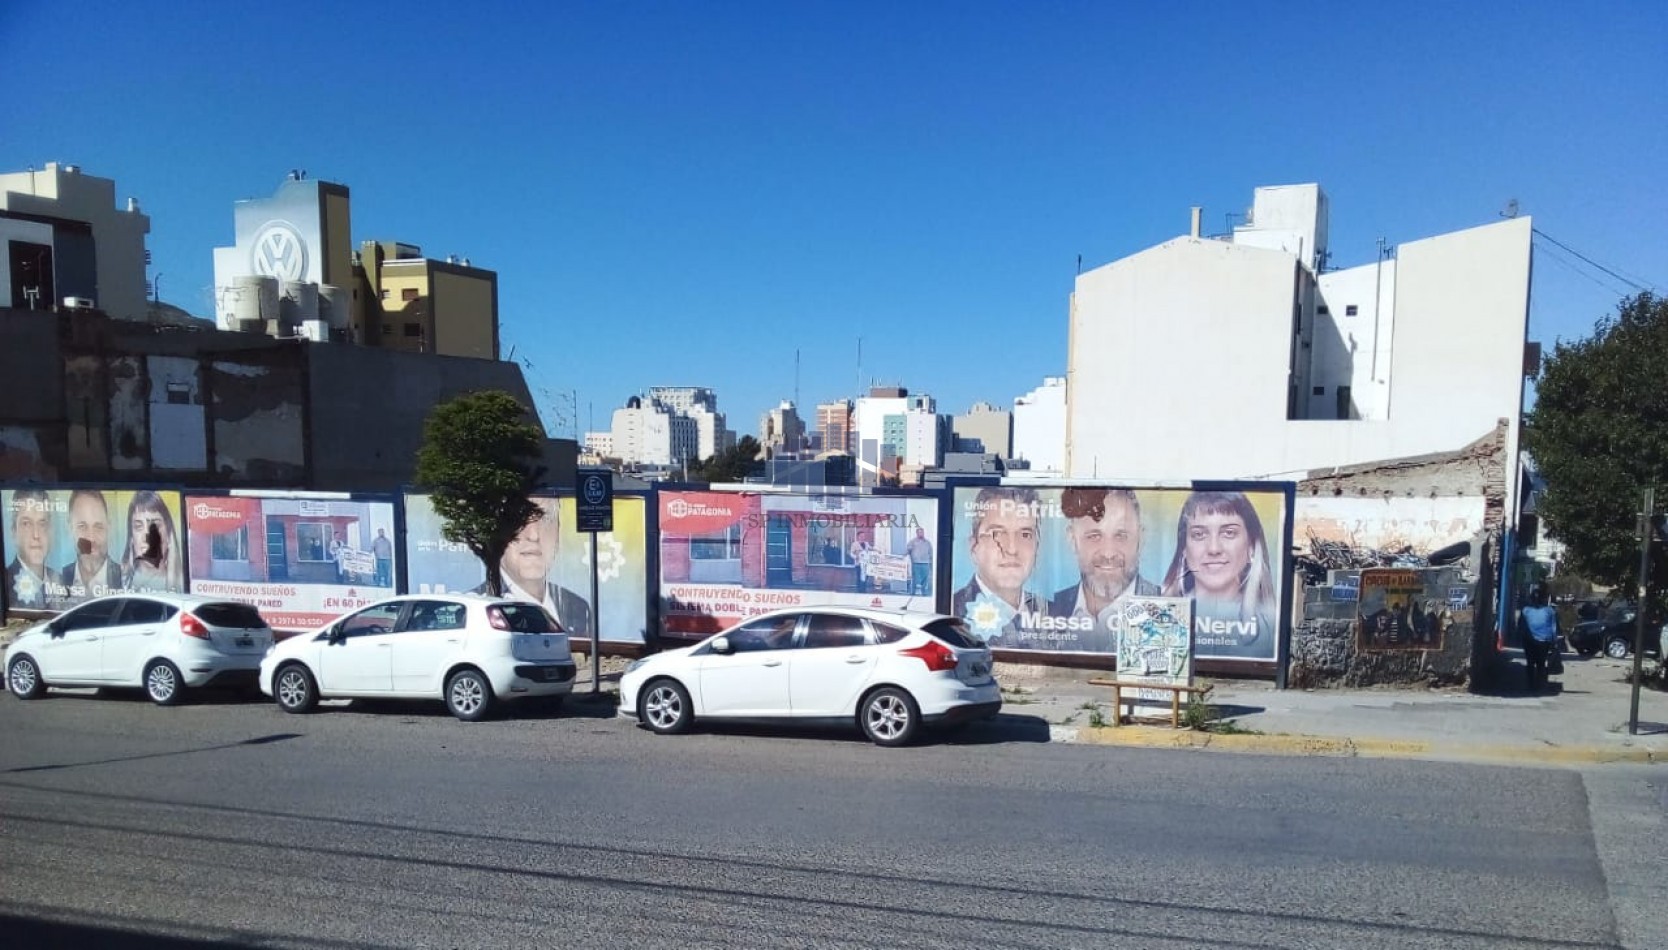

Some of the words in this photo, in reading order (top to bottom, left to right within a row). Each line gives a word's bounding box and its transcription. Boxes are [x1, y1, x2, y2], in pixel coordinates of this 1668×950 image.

[26, 498, 67, 512] Patria
[964, 501, 997, 511] Unión
[687, 507, 731, 517] PATAGONIA
[197, 584, 259, 596] CONTRUYENDO
[670, 588, 751, 602] CONTRUYENDO
[1021, 613, 1093, 631] Massa
[1195, 615, 1258, 637] Nervi
[1021, 631, 1077, 643] presidente
